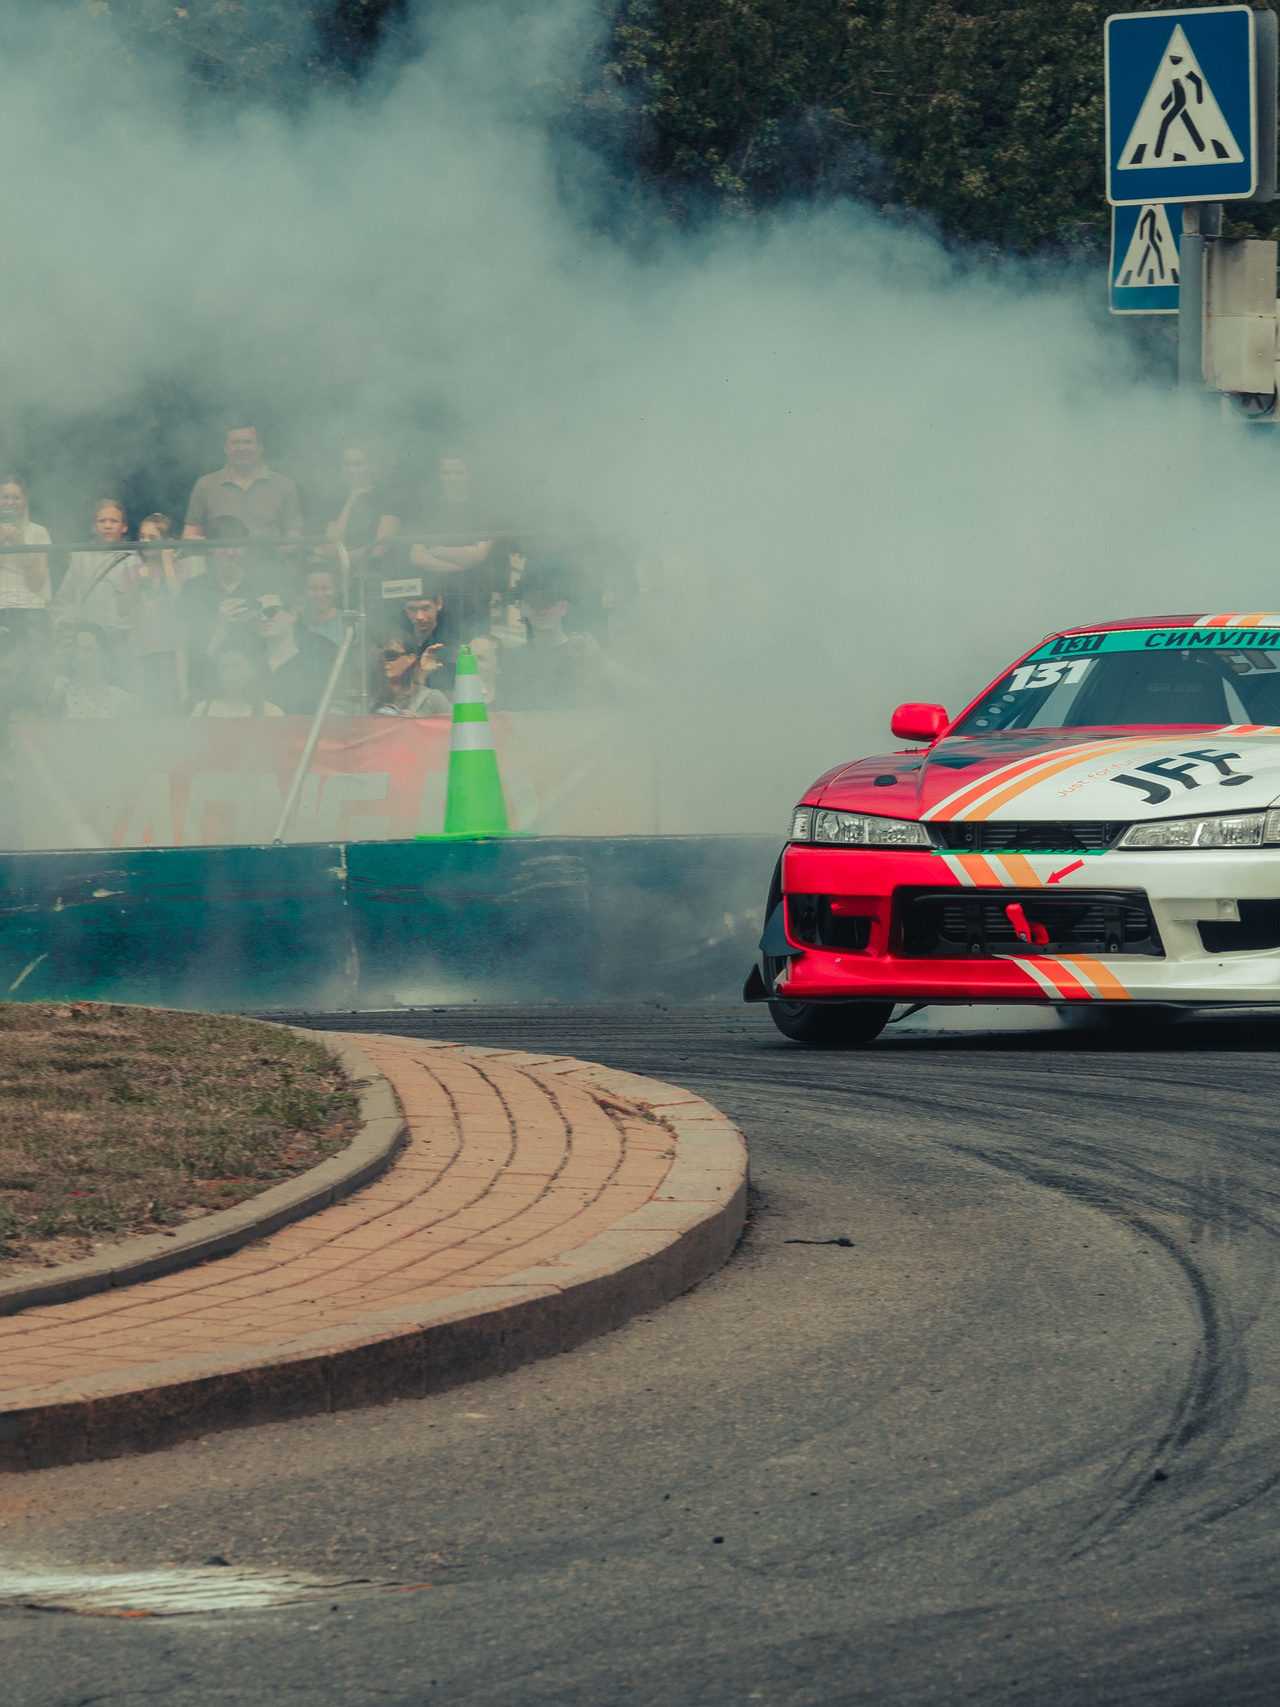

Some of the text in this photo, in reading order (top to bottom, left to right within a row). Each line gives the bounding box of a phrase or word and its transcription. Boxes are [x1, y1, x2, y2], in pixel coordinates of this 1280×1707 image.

[1057, 637, 1097, 653] 131
[1007, 658, 1094, 692] 131
[1086, 766, 1112, 781] for
[1109, 749, 1254, 805] JFF
